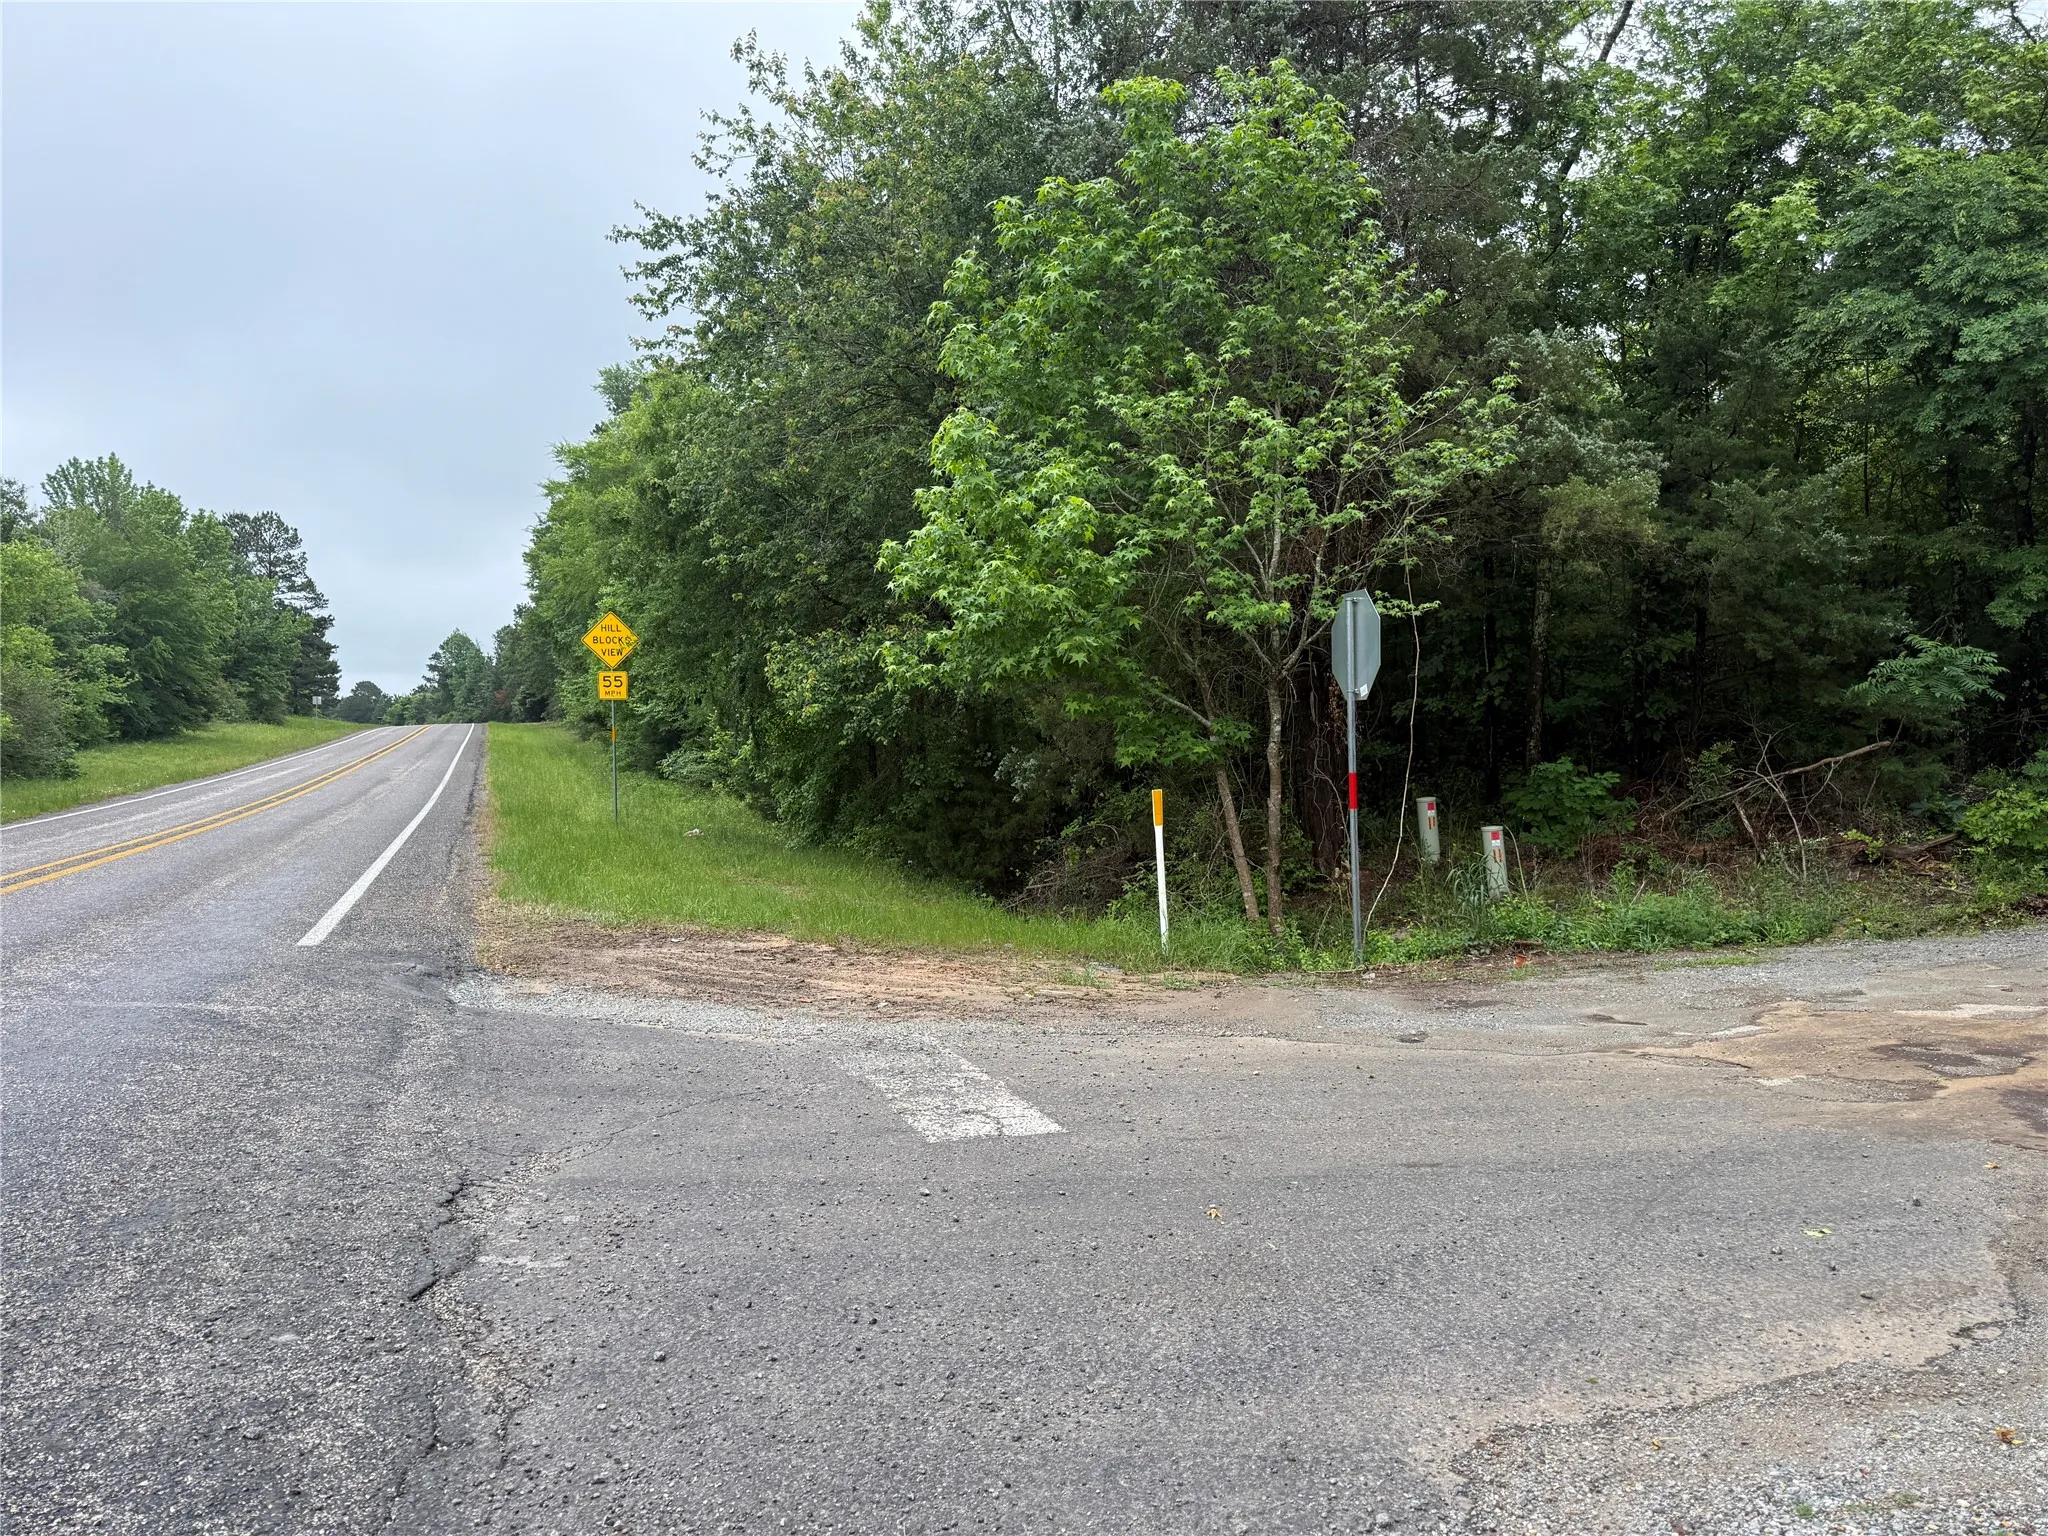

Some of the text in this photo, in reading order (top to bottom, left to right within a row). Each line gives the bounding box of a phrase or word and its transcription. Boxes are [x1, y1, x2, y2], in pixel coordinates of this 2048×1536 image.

[601, 624, 622, 632] HILL
[592, 635, 632, 645] BLOCKS
[601, 648, 623, 657] VIEW
[602, 675, 623, 688] 55
